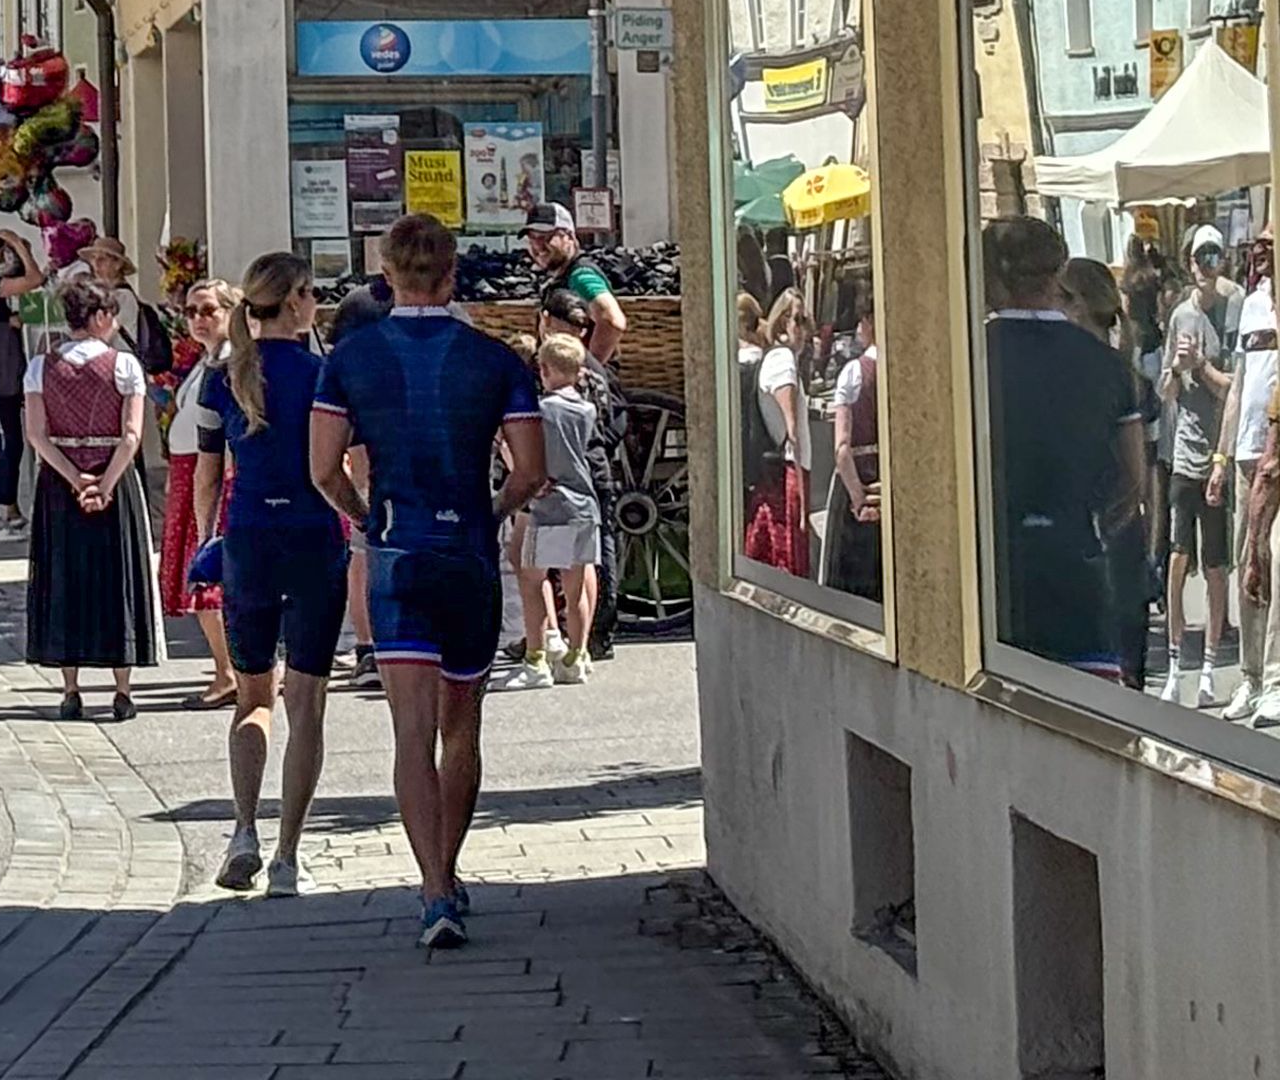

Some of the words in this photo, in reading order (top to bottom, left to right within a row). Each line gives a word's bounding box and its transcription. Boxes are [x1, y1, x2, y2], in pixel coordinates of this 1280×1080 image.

[621, 14, 663, 30] Piding
[621, 32, 662, 45] Anger
[408, 155, 446, 168] Musi
[408, 168, 455, 183] Stund
